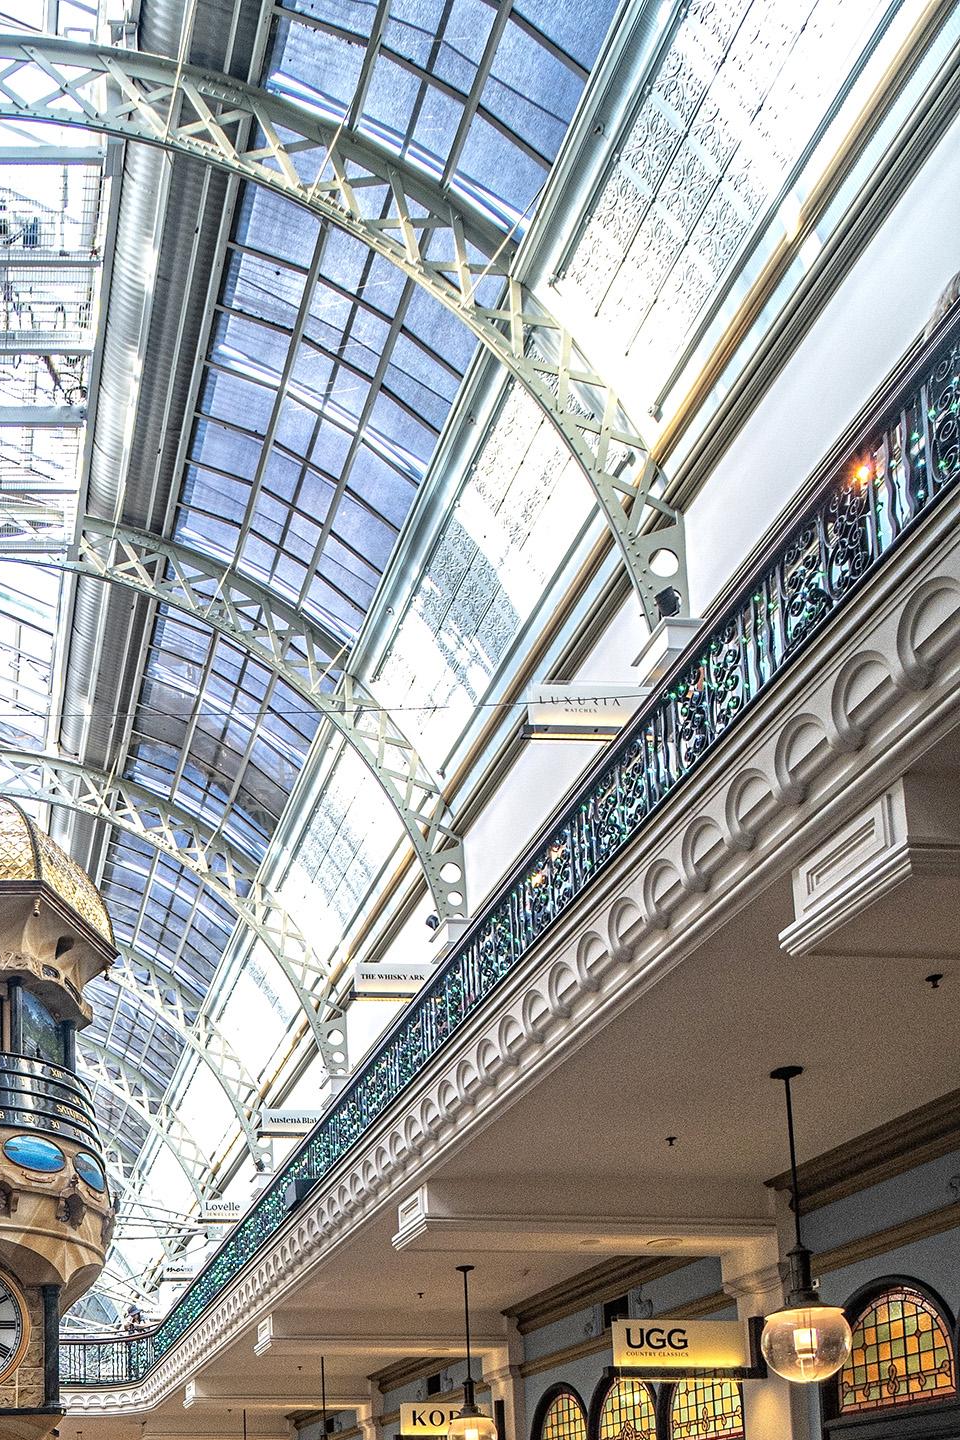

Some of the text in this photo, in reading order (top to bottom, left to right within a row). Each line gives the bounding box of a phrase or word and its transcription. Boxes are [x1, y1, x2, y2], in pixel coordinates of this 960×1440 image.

[539, 696, 622, 707] LUXURIA
[205, 1202, 240, 1211] Lovelle
[626, 1328, 688, 1350] UGG
